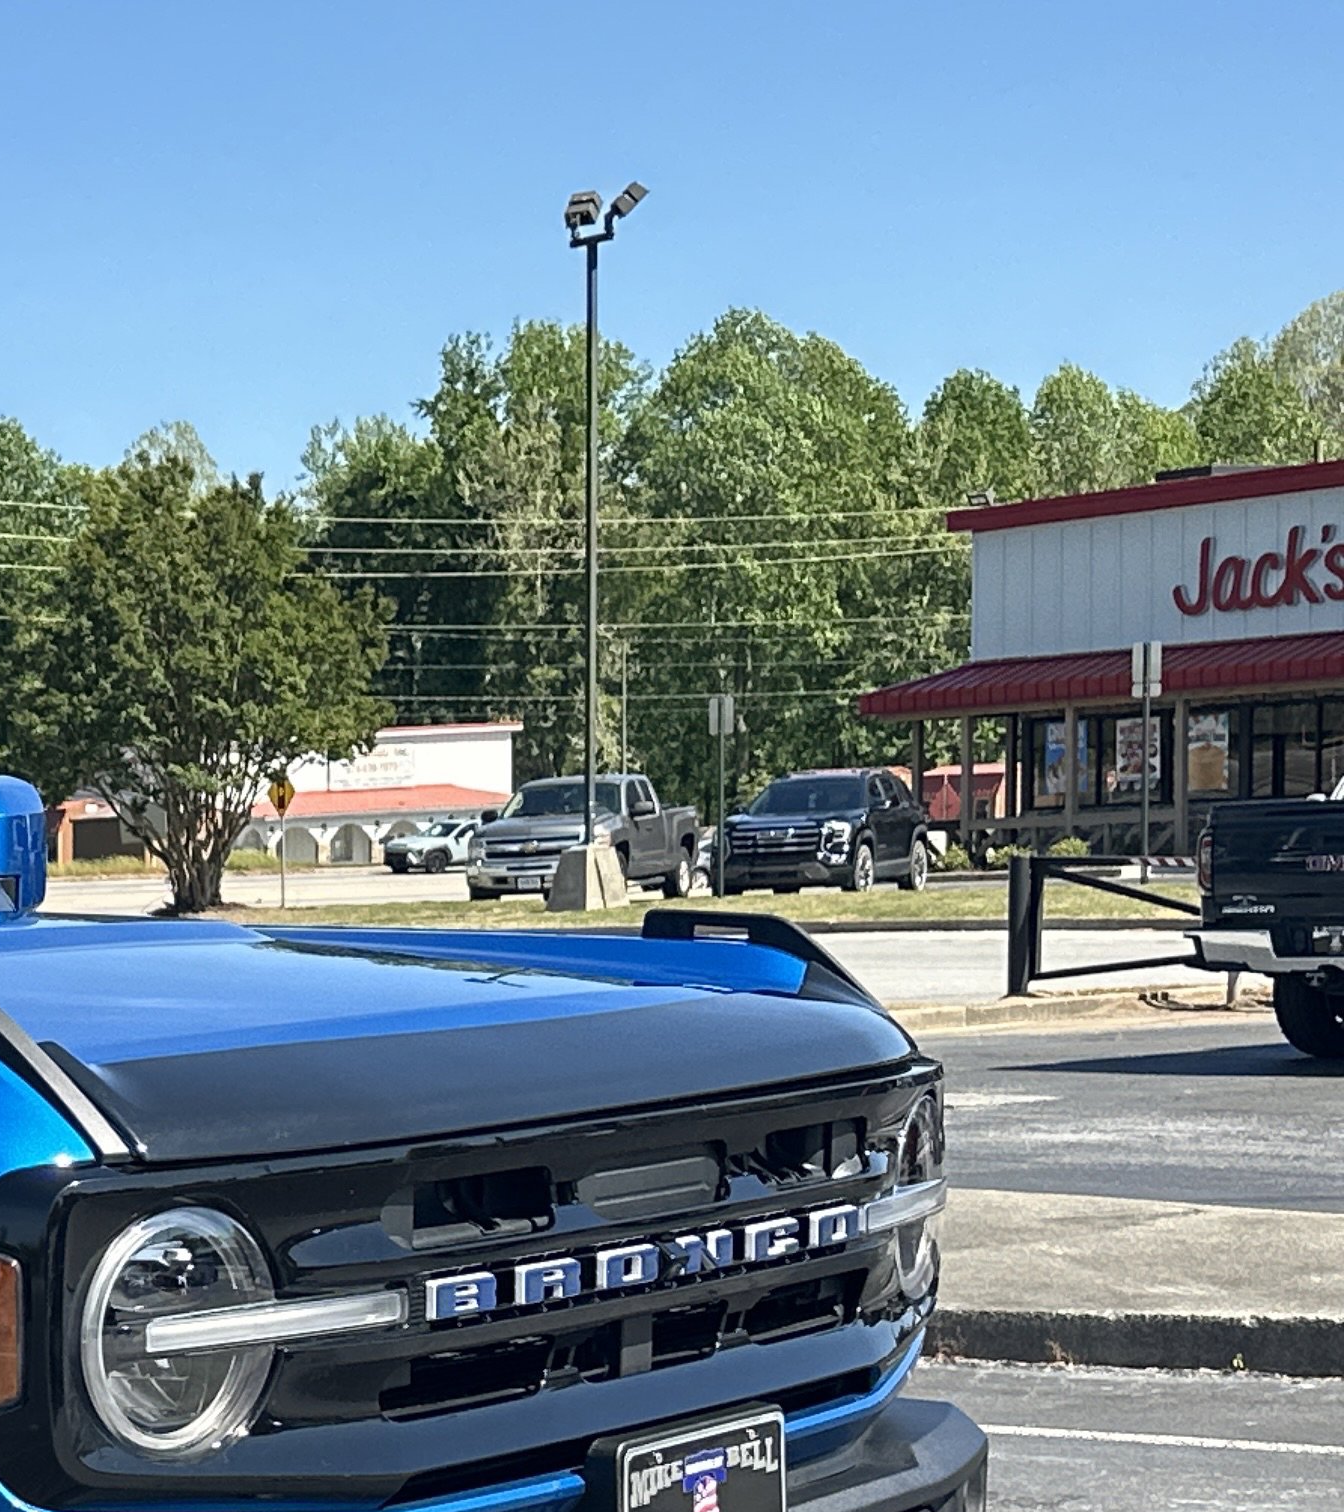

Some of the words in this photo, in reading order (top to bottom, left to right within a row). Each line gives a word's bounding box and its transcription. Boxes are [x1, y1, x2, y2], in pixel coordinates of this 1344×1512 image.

[1172, 523, 1344, 616] Jack's
[423, 1203, 861, 1321] BRONCO
[629, 1459, 684, 1509] MIKE
[725, 1436, 779, 1474] BELL
